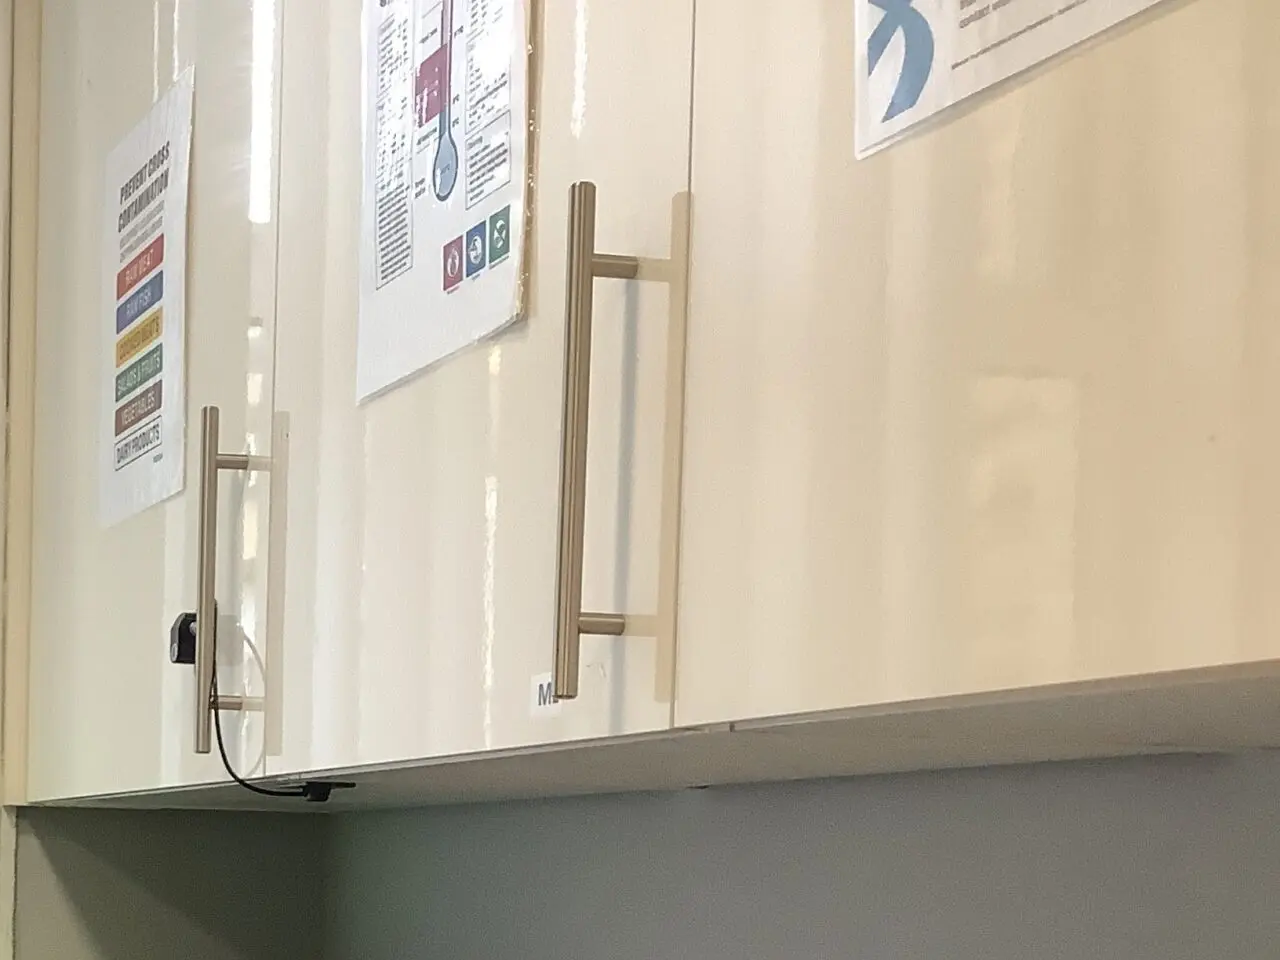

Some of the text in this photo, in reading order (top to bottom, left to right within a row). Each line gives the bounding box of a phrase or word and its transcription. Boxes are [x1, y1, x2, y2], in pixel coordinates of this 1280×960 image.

[120, 140, 170, 205] PREVENT CROSS
[118, 168, 169, 233] CONTAMINATION
[140, 248, 154, 277] MEAT
[140, 286, 152, 310] FISH
[122, 390, 156, 425] VEGETABLES
[117, 422, 160, 465] DAIRY PRODUCTS
